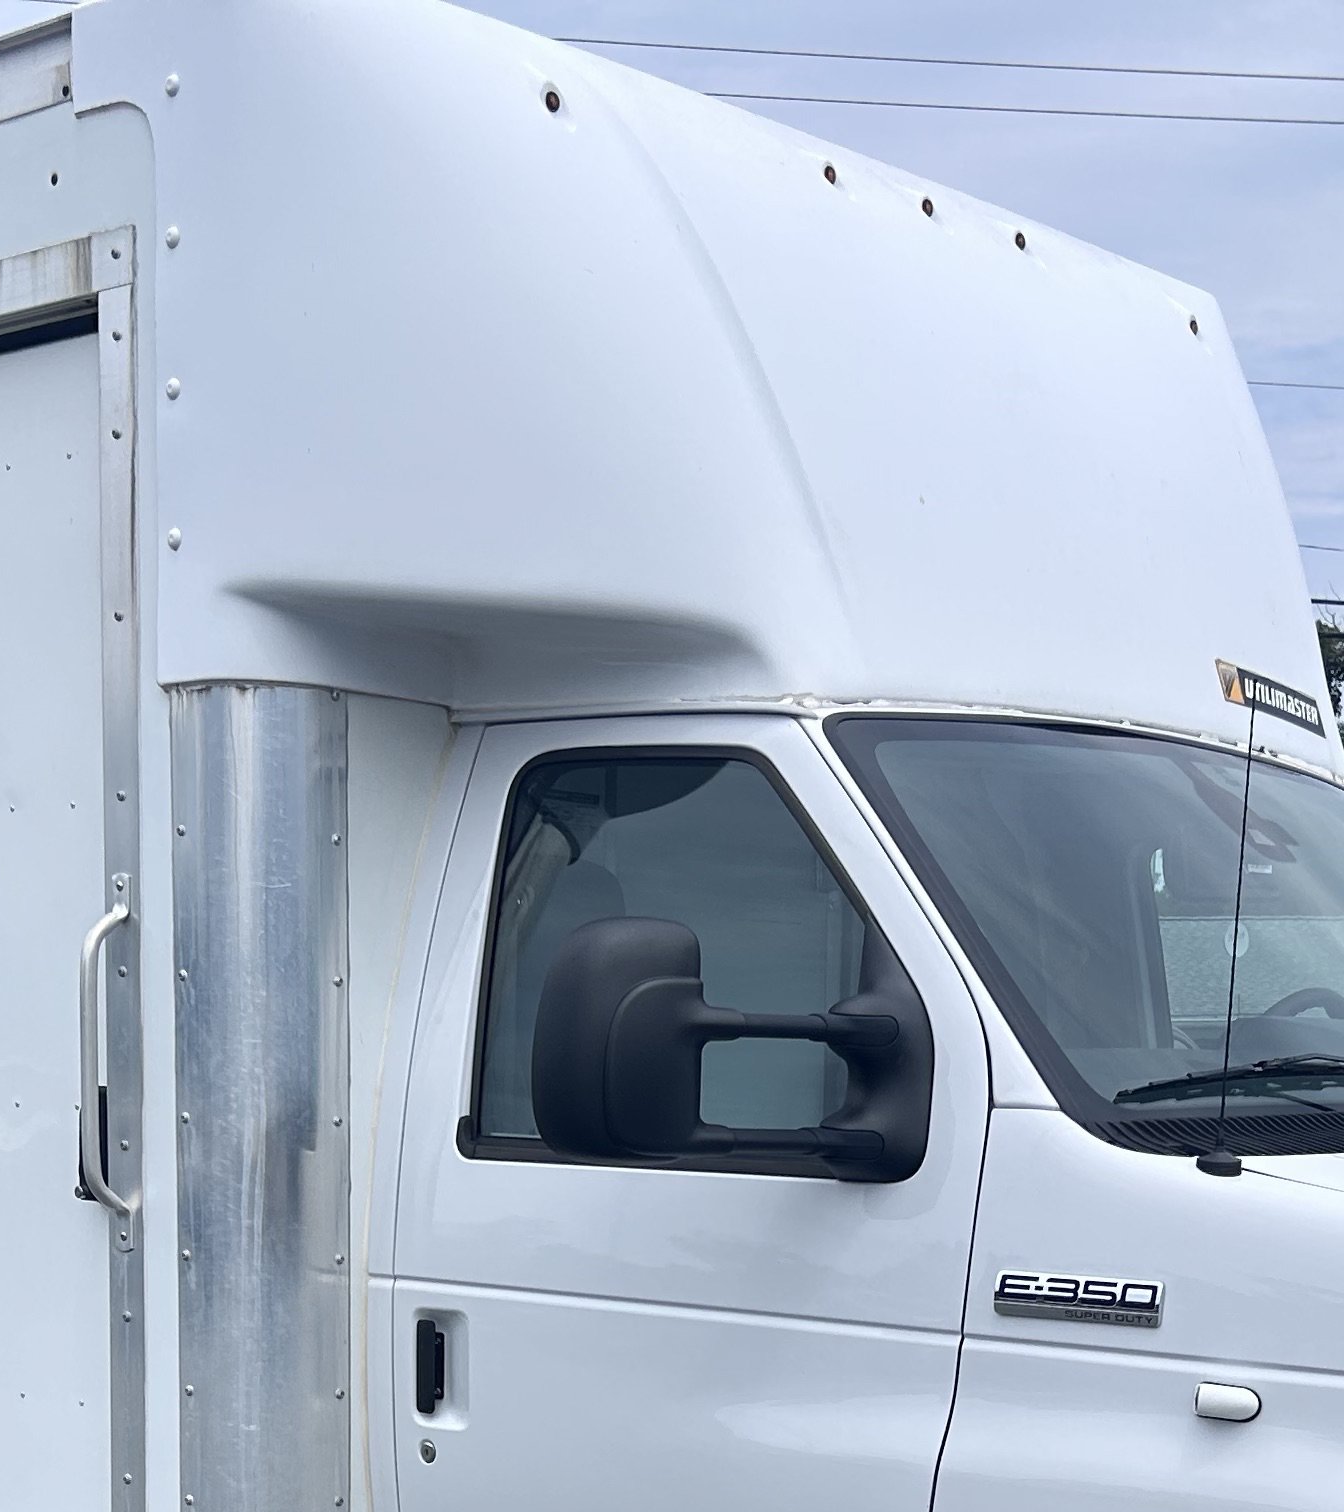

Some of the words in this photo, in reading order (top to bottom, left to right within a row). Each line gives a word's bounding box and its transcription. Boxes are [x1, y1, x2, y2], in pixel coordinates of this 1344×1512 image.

[999, 1274, 1159, 1310] E-350
[1064, 1309, 1111, 1321] SUPER
[1114, 1313, 1153, 1325] DUTY
